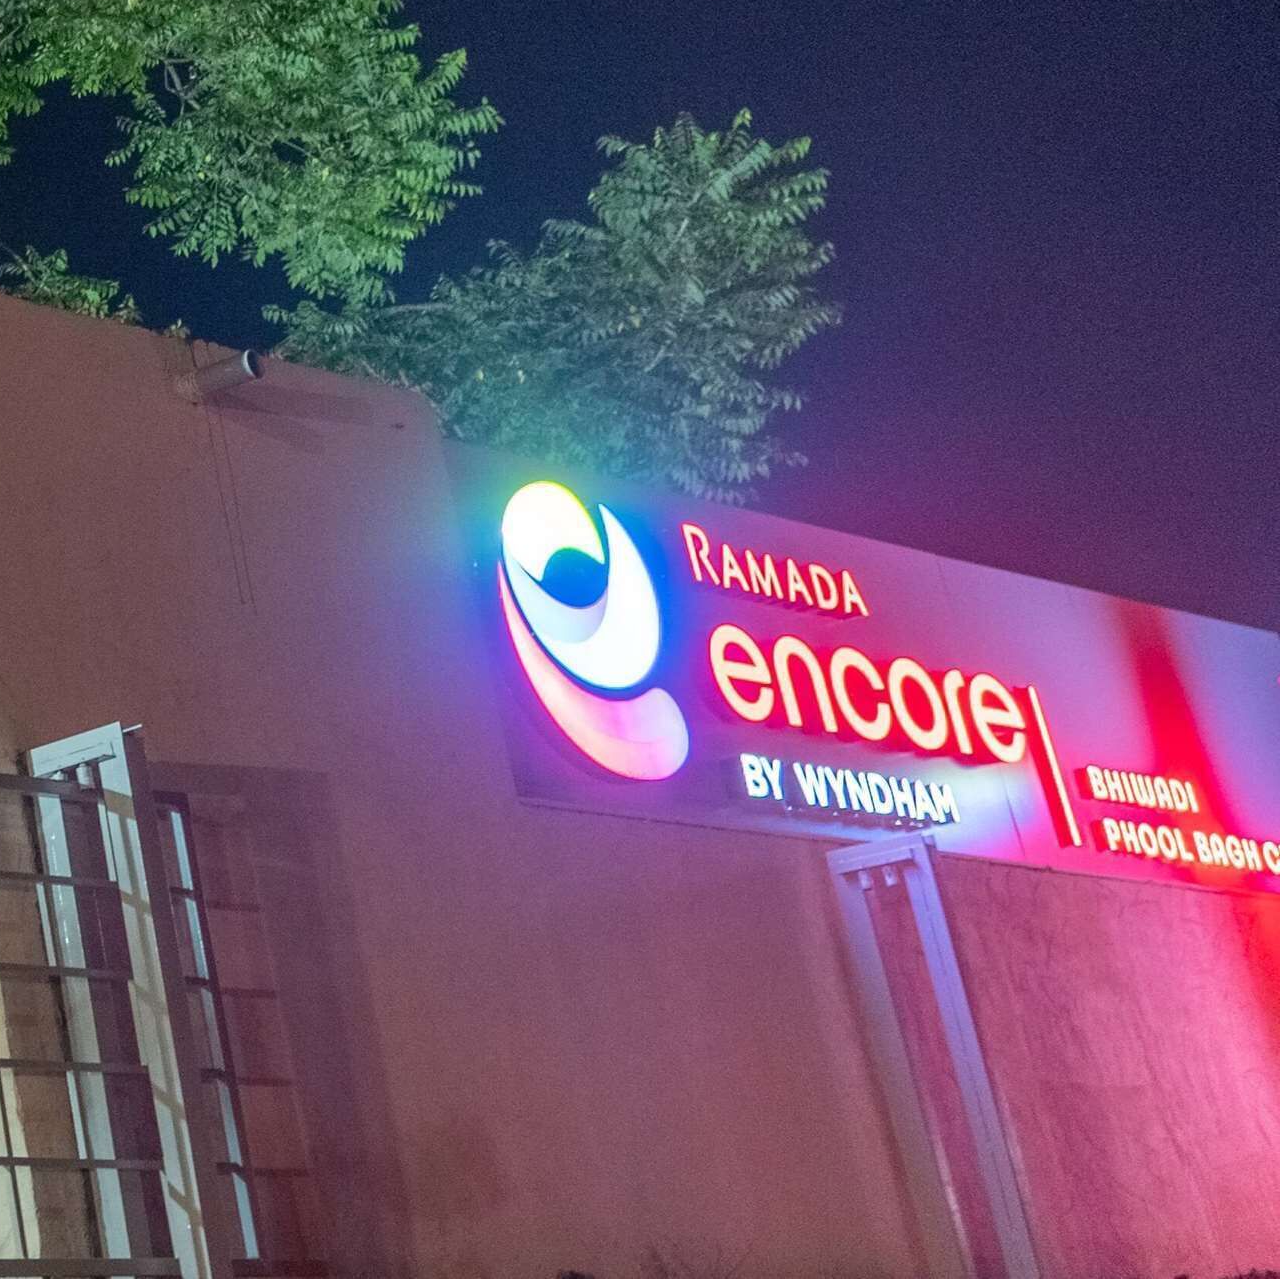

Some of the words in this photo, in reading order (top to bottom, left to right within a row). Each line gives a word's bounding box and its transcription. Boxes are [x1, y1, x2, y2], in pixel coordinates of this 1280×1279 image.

[681, 523, 870, 617] RAMADA
[709, 623, 1027, 764] encore
[740, 753, 785, 801] BY
[793, 762, 961, 824] WYNDHAM
[1086, 764, 1200, 814] BHIWADI
[1102, 816, 1194, 863] PHOOL
[1192, 830, 1263, 872] BAGH
[1261, 840, 1280, 876] C
